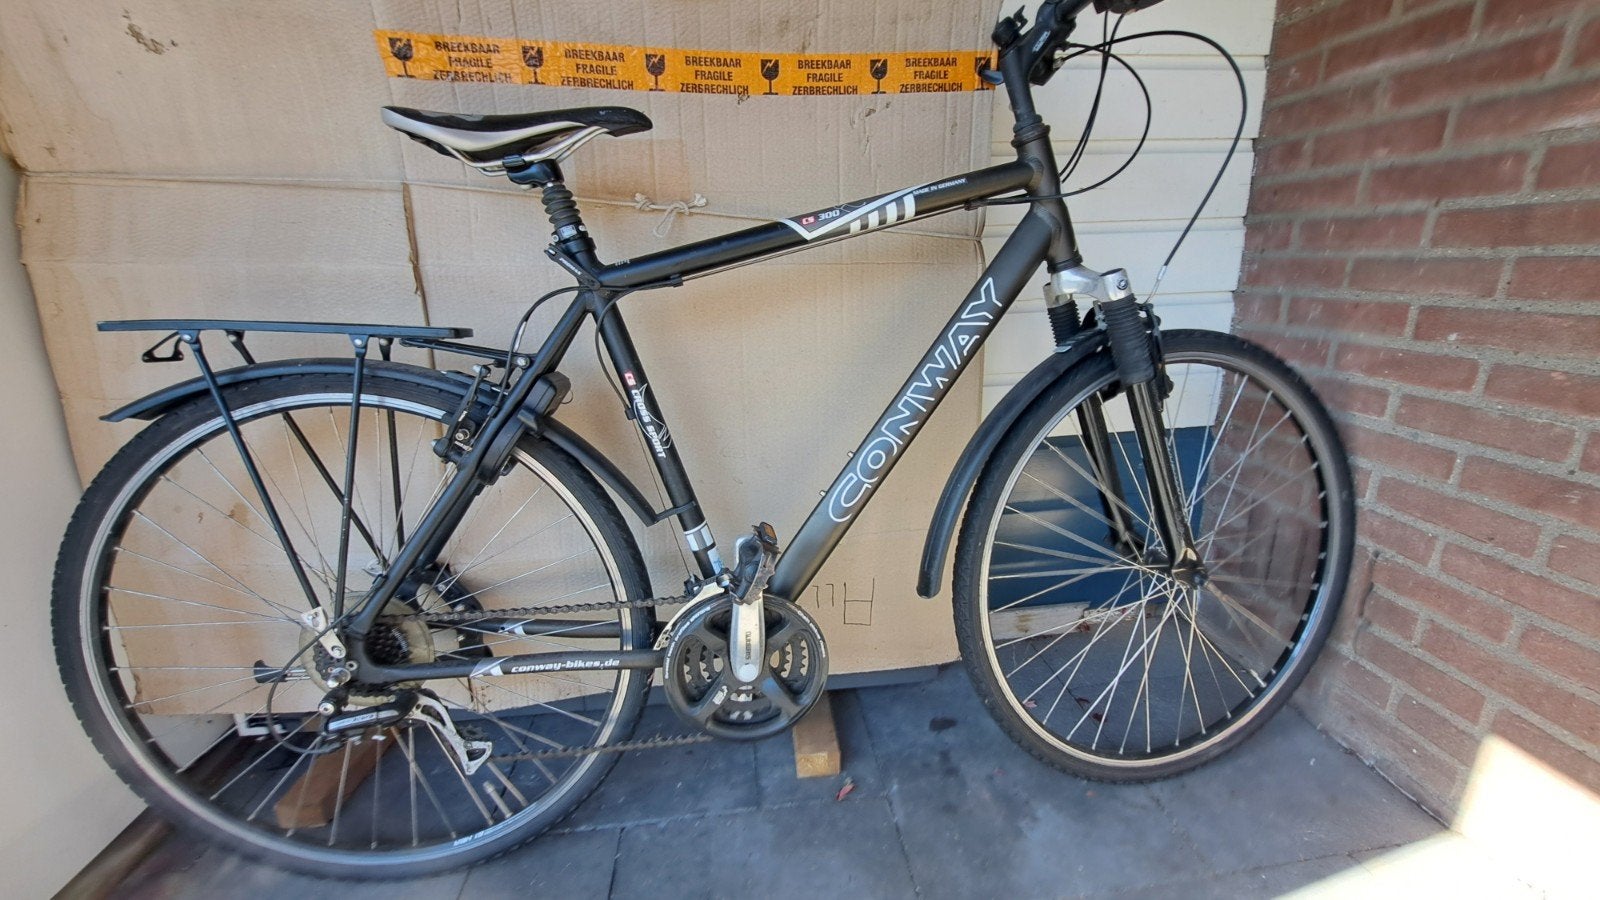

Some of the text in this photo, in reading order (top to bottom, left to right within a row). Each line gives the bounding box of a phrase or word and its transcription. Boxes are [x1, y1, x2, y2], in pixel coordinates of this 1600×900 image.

[434, 41, 500, 54] BREEKBAAR
[564, 49, 625, 62] BREEKBAAR
[685, 55, 742, 68] BREEKBAAR
[798, 59, 852, 70] BREEKBAAR
[905, 57, 957, 68] BREEKBAAR
[575, 63, 617, 76] FRAGILE
[695, 70, 734, 81] FRAGILE
[913, 70, 949, 80] FRAGILE
[560, 76, 634, 91] ZERBRECHLICH
[806, 73, 844, 83] FRAGILE
[680, 83, 749, 96] ZERBRECHLICH
[792, 85, 858, 96] ZERBRECHLICH
[900, 82, 963, 94] ZERBRECHLICH
[913, 187, 930, 196] MADE
[938, 178, 967, 188] GERMANY
[818, 209, 840, 222] 300
[828, 277, 1003, 523] CONWAY
[631, 389, 652, 424] CROSS
[646, 425, 667, 459] SPORT
[511, 658, 620, 674] conway-bikes.de
